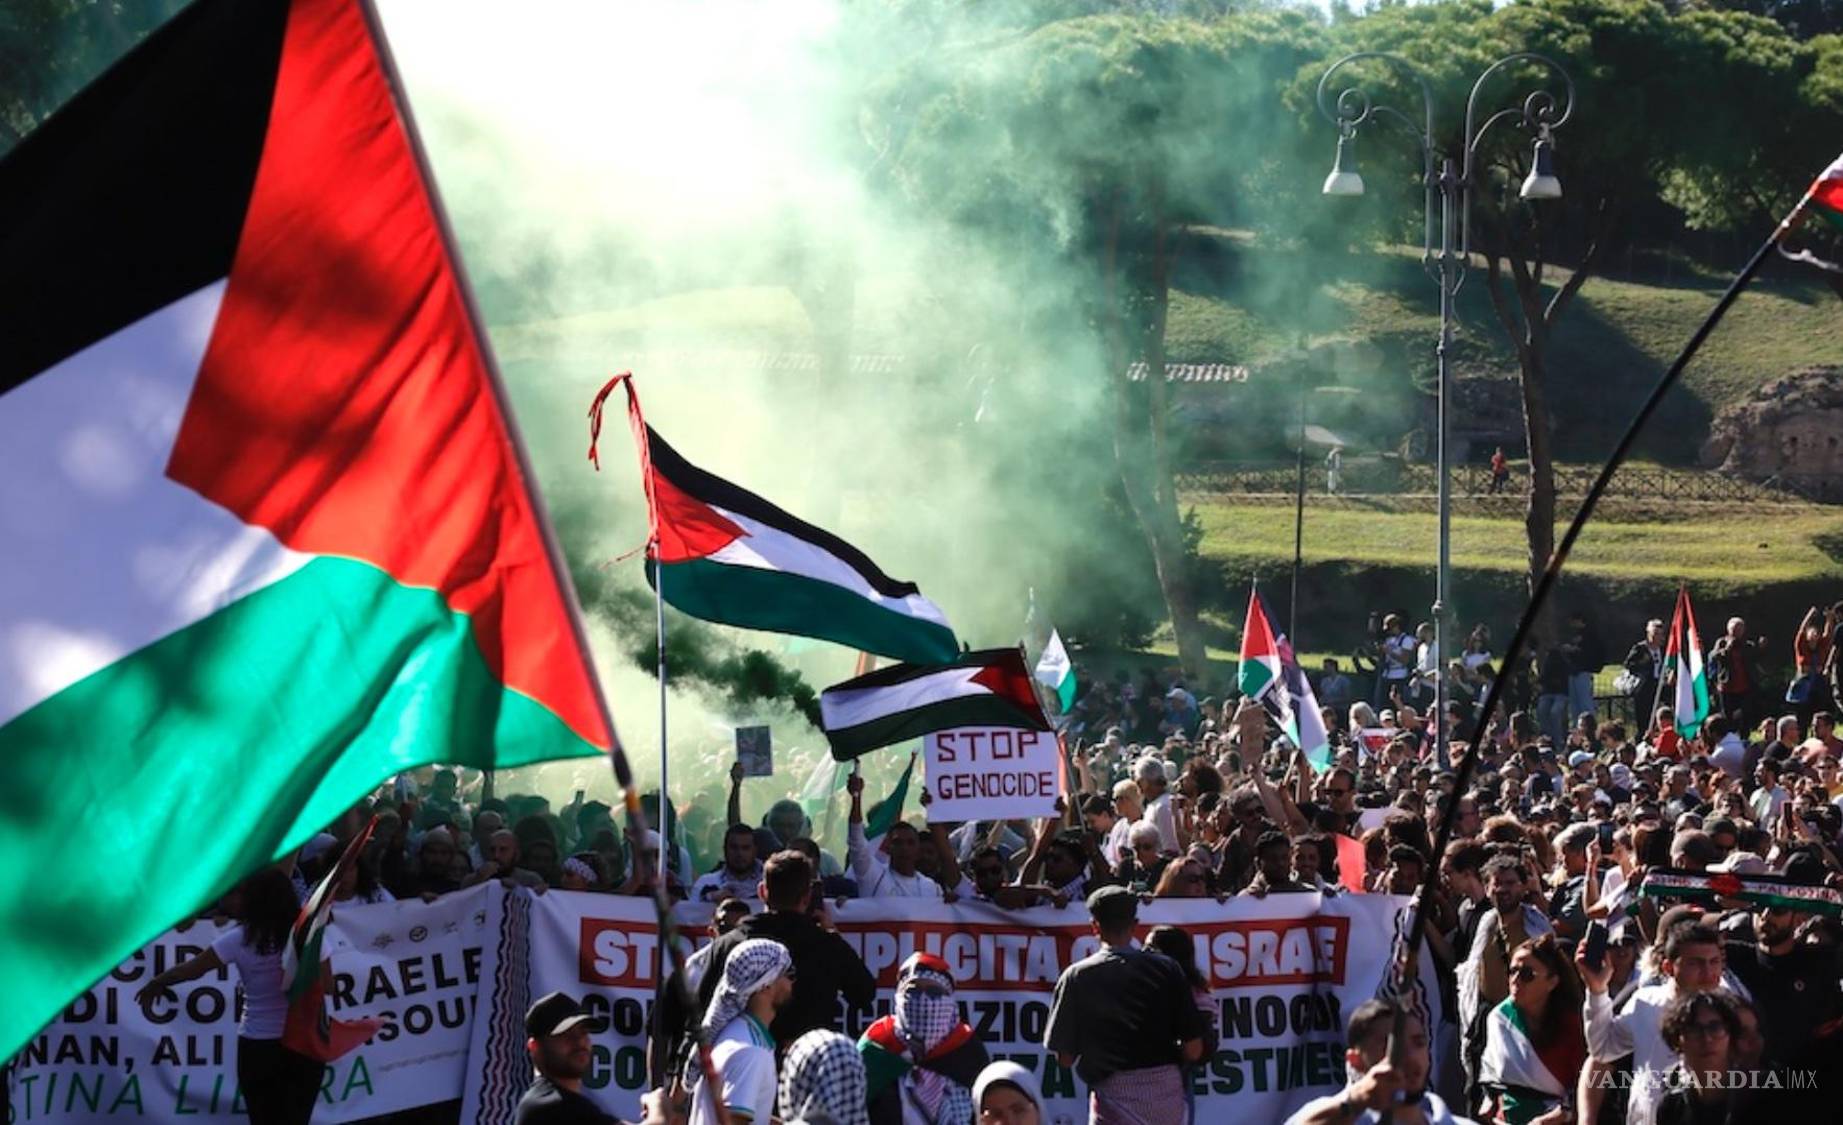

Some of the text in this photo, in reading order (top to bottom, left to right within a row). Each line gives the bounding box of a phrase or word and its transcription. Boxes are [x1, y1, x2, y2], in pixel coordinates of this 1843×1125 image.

[936, 731, 1039, 762] STOP
[937, 772, 1053, 799] GENOCIDE
[152, 1034, 224, 1066] ALI
